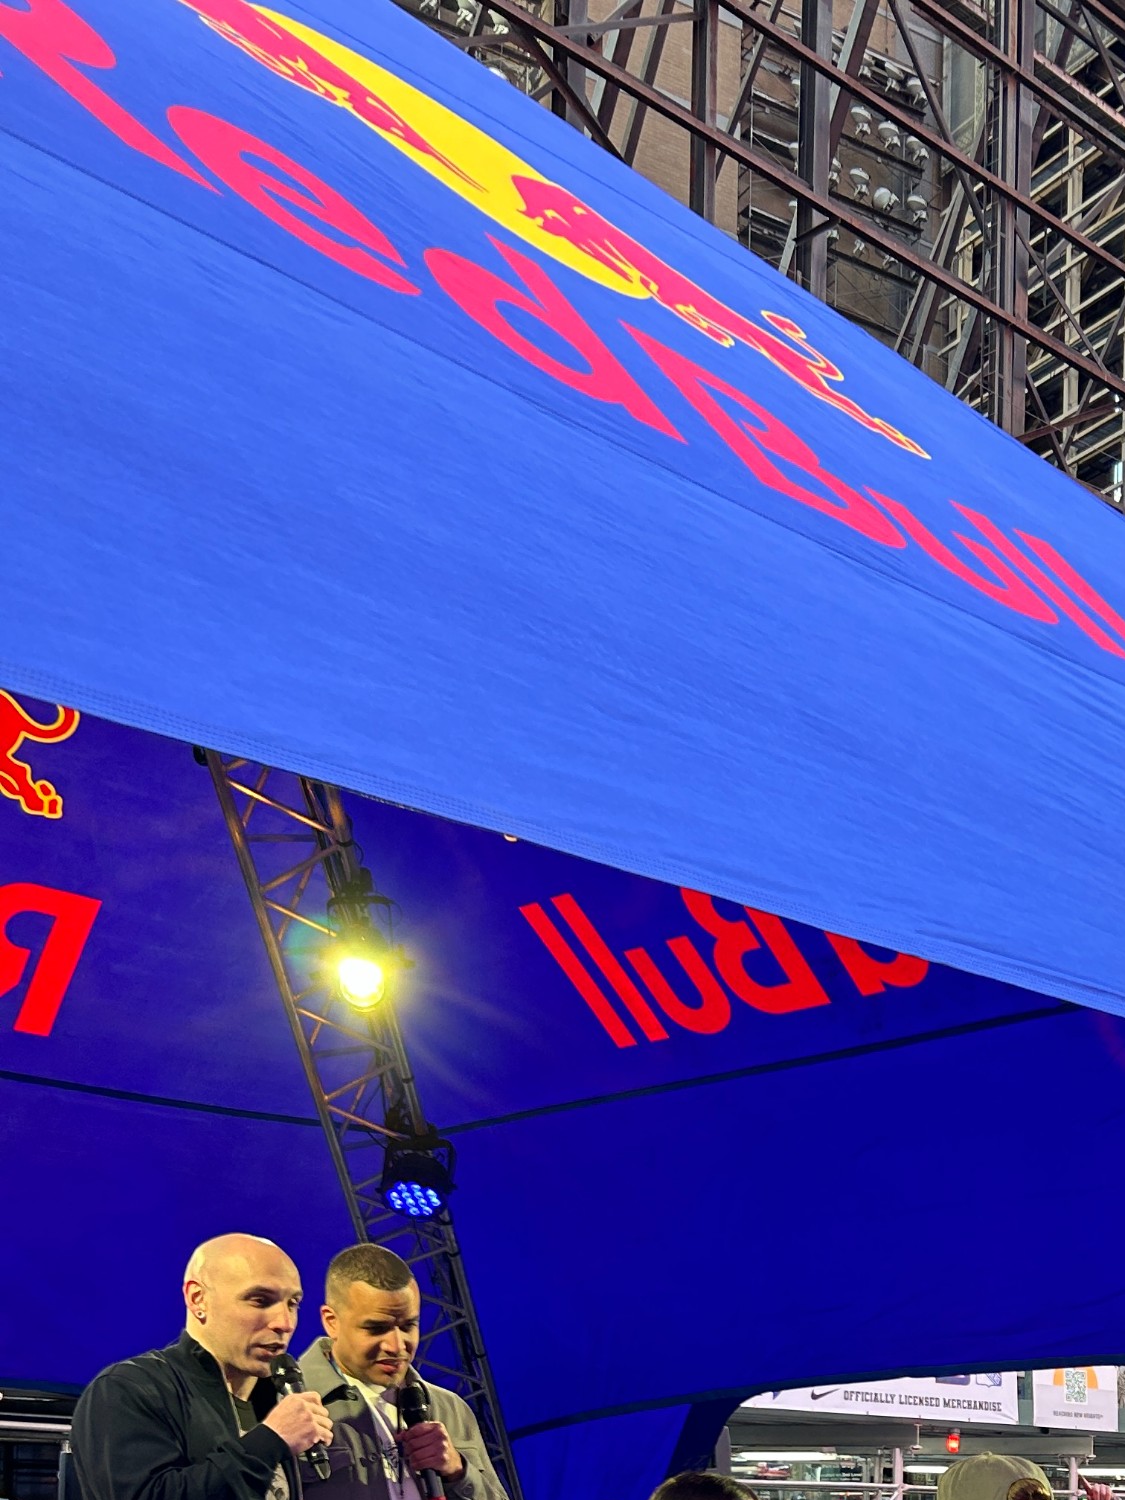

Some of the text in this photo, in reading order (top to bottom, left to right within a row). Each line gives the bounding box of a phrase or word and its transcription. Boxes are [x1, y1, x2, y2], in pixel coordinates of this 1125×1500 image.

[843, 1390, 1002, 1412] OFFICIALLY LICENSED MERCHANDISE
